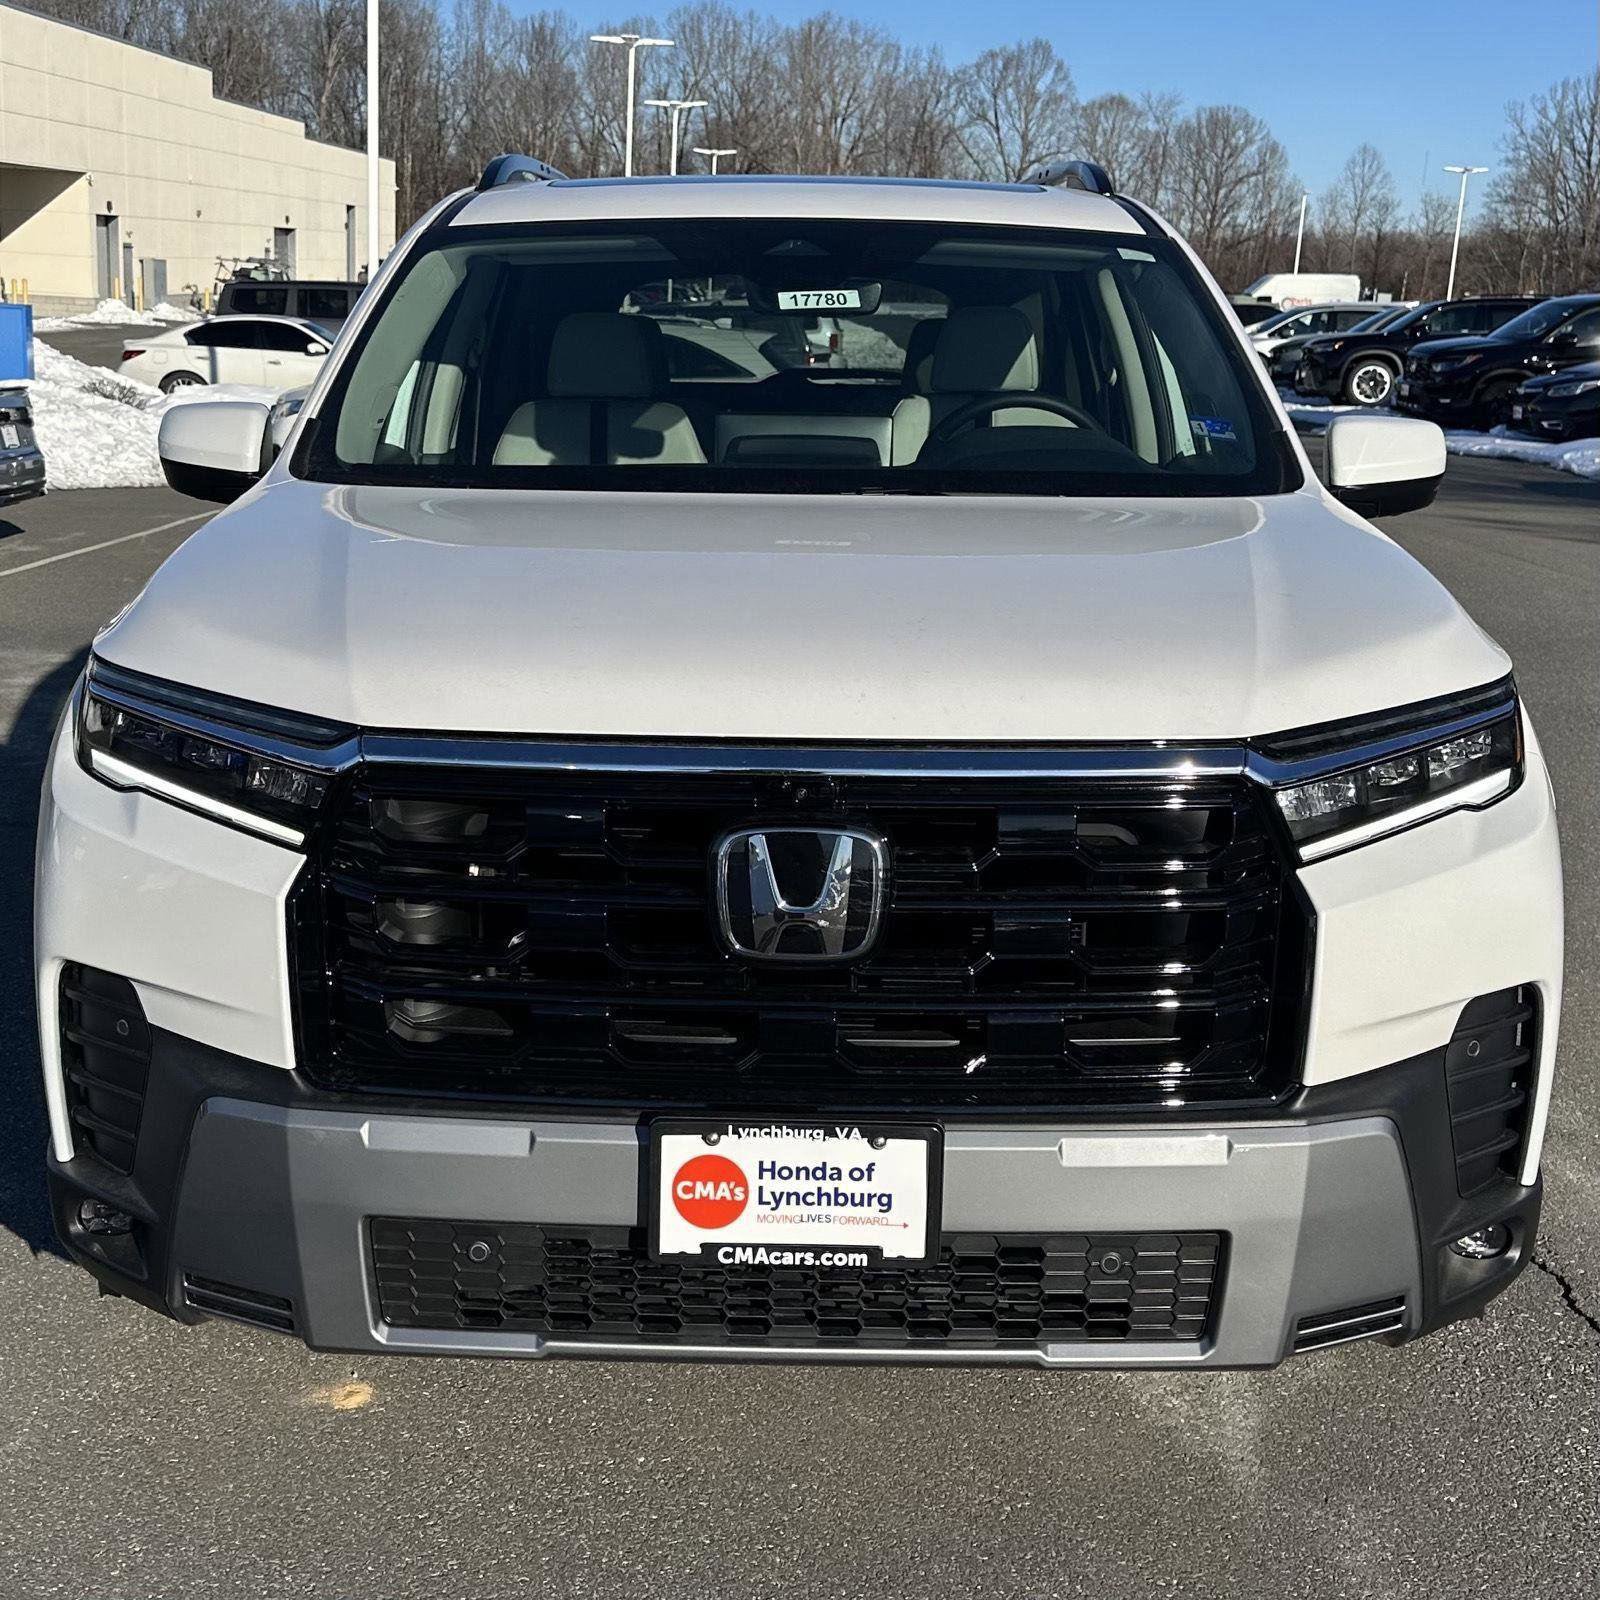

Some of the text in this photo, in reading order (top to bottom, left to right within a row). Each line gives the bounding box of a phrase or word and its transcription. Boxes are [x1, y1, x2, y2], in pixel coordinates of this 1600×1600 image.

[790, 293, 848, 307] 17780
[835, 1127, 862, 1140] VA
[758, 1160, 875, 1182] Honda of
[676, 1180, 746, 1201] CMA's
[757, 1186, 893, 1213] Lynchburg
[717, 1246, 869, 1267] CMAcars.com
